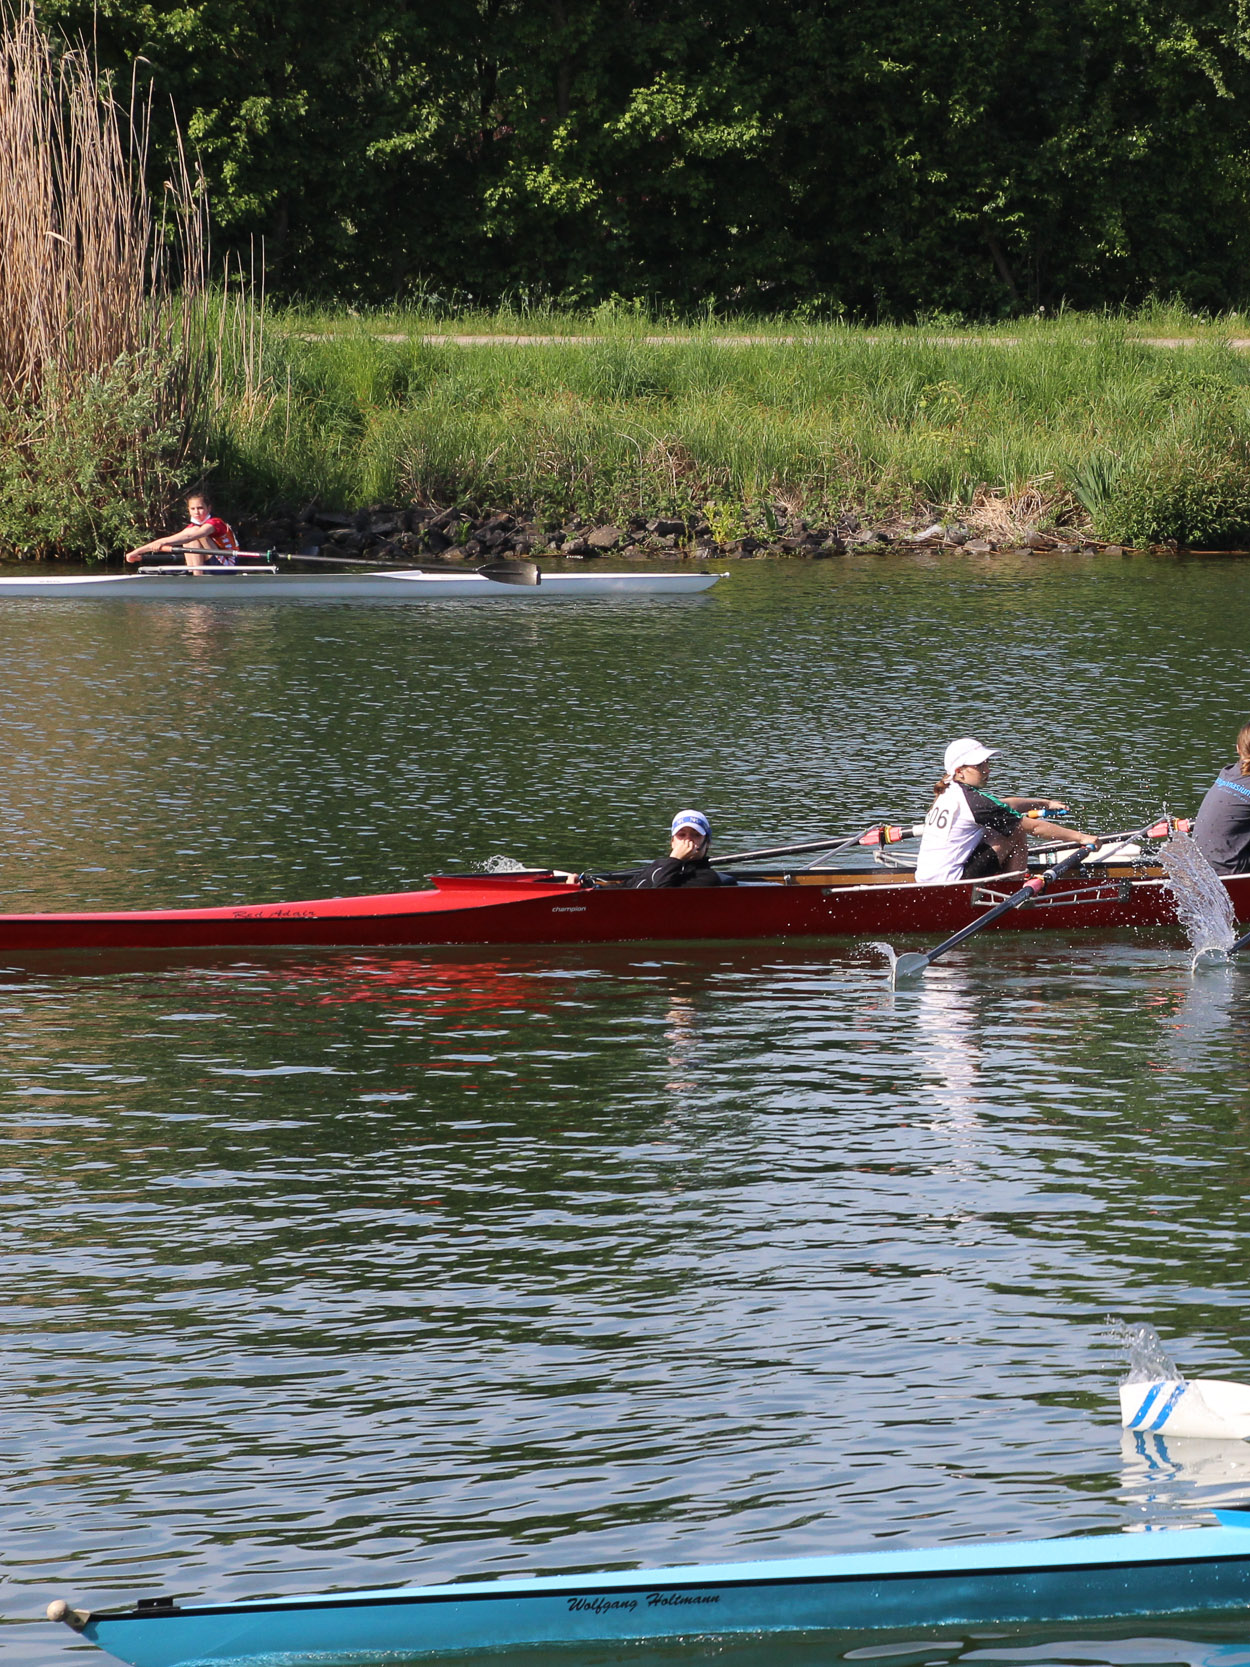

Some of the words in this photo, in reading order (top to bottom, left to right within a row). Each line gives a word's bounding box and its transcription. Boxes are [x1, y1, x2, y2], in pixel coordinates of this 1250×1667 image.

[927, 806, 950, 829] 06
[232, 911, 264, 919] Red
[269, 909, 316, 919] Adair
[551, 906, 587, 914] champion
[567, 1597, 639, 1615] Wolfgang
[645, 1592, 721, 1607] Holtmann
